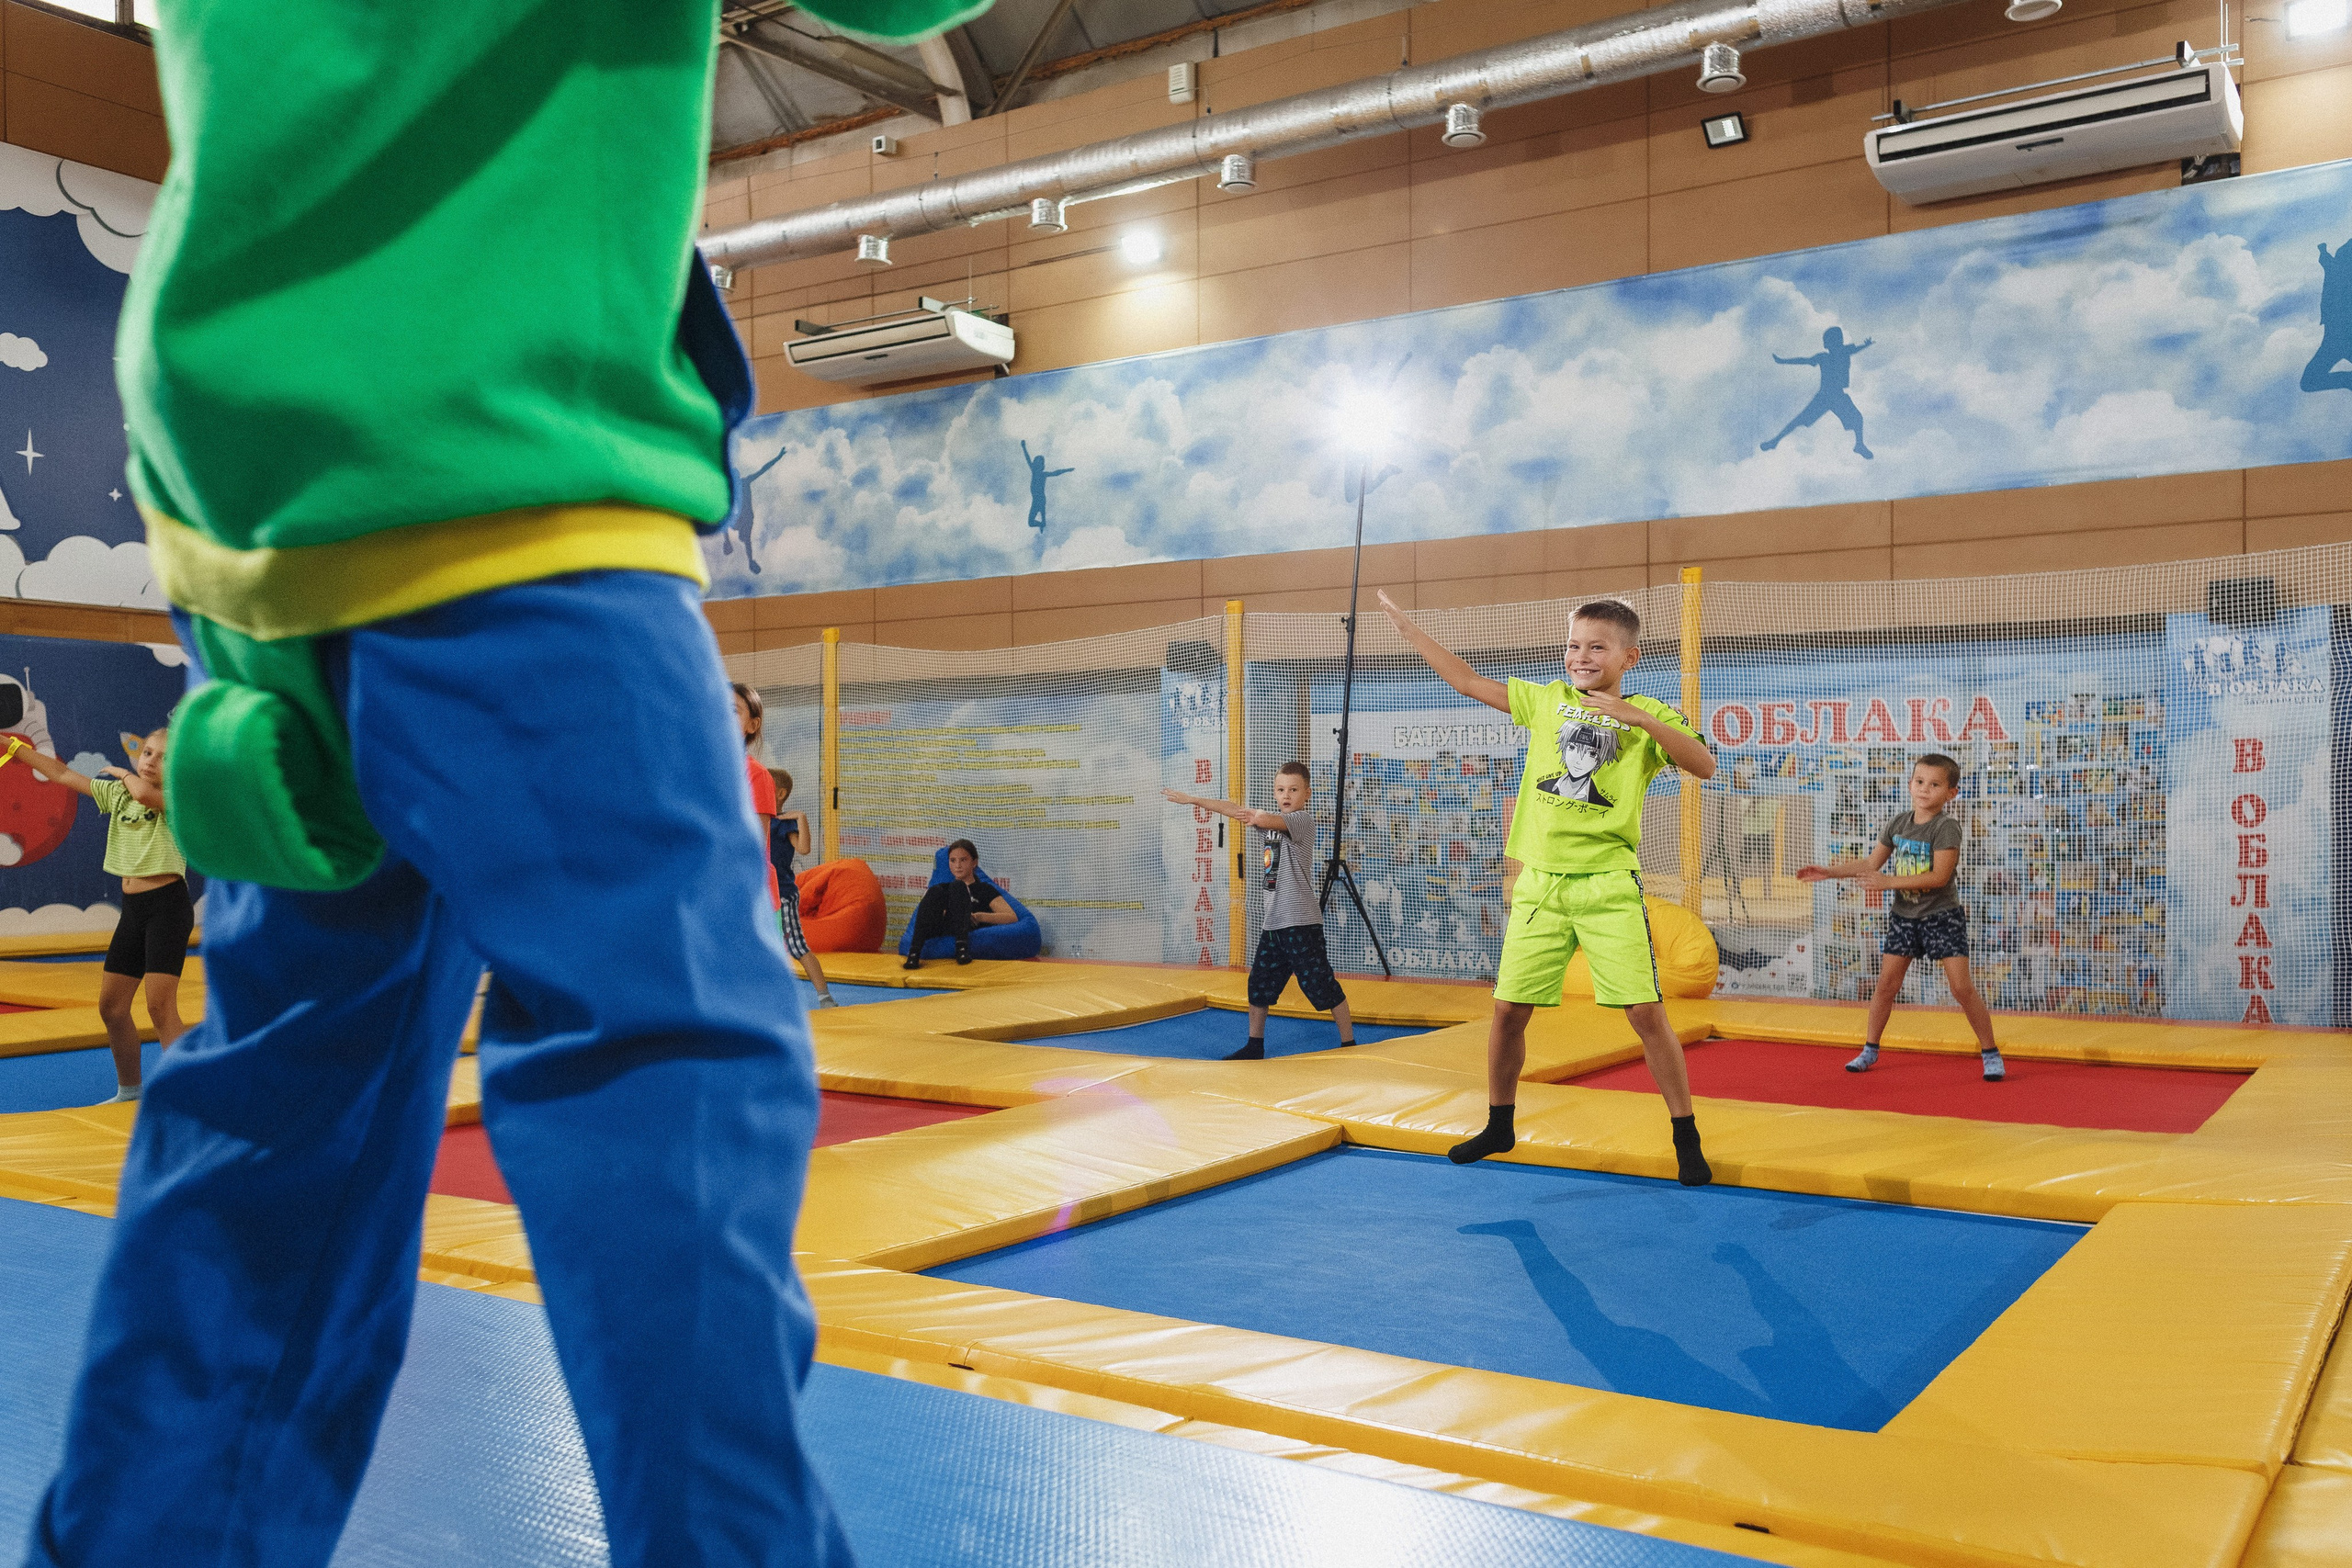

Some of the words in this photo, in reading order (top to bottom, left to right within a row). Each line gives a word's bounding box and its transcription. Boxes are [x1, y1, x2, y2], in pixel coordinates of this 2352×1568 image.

[1711, 696, 2009, 747] ОБЛАКА
[1194, 759, 1213, 784] В
[2232, 738, 2267, 773] В
[2230, 793, 2275, 1024] ОБЛАКА
[1387, 947, 1494, 970] ОБЛАКА
